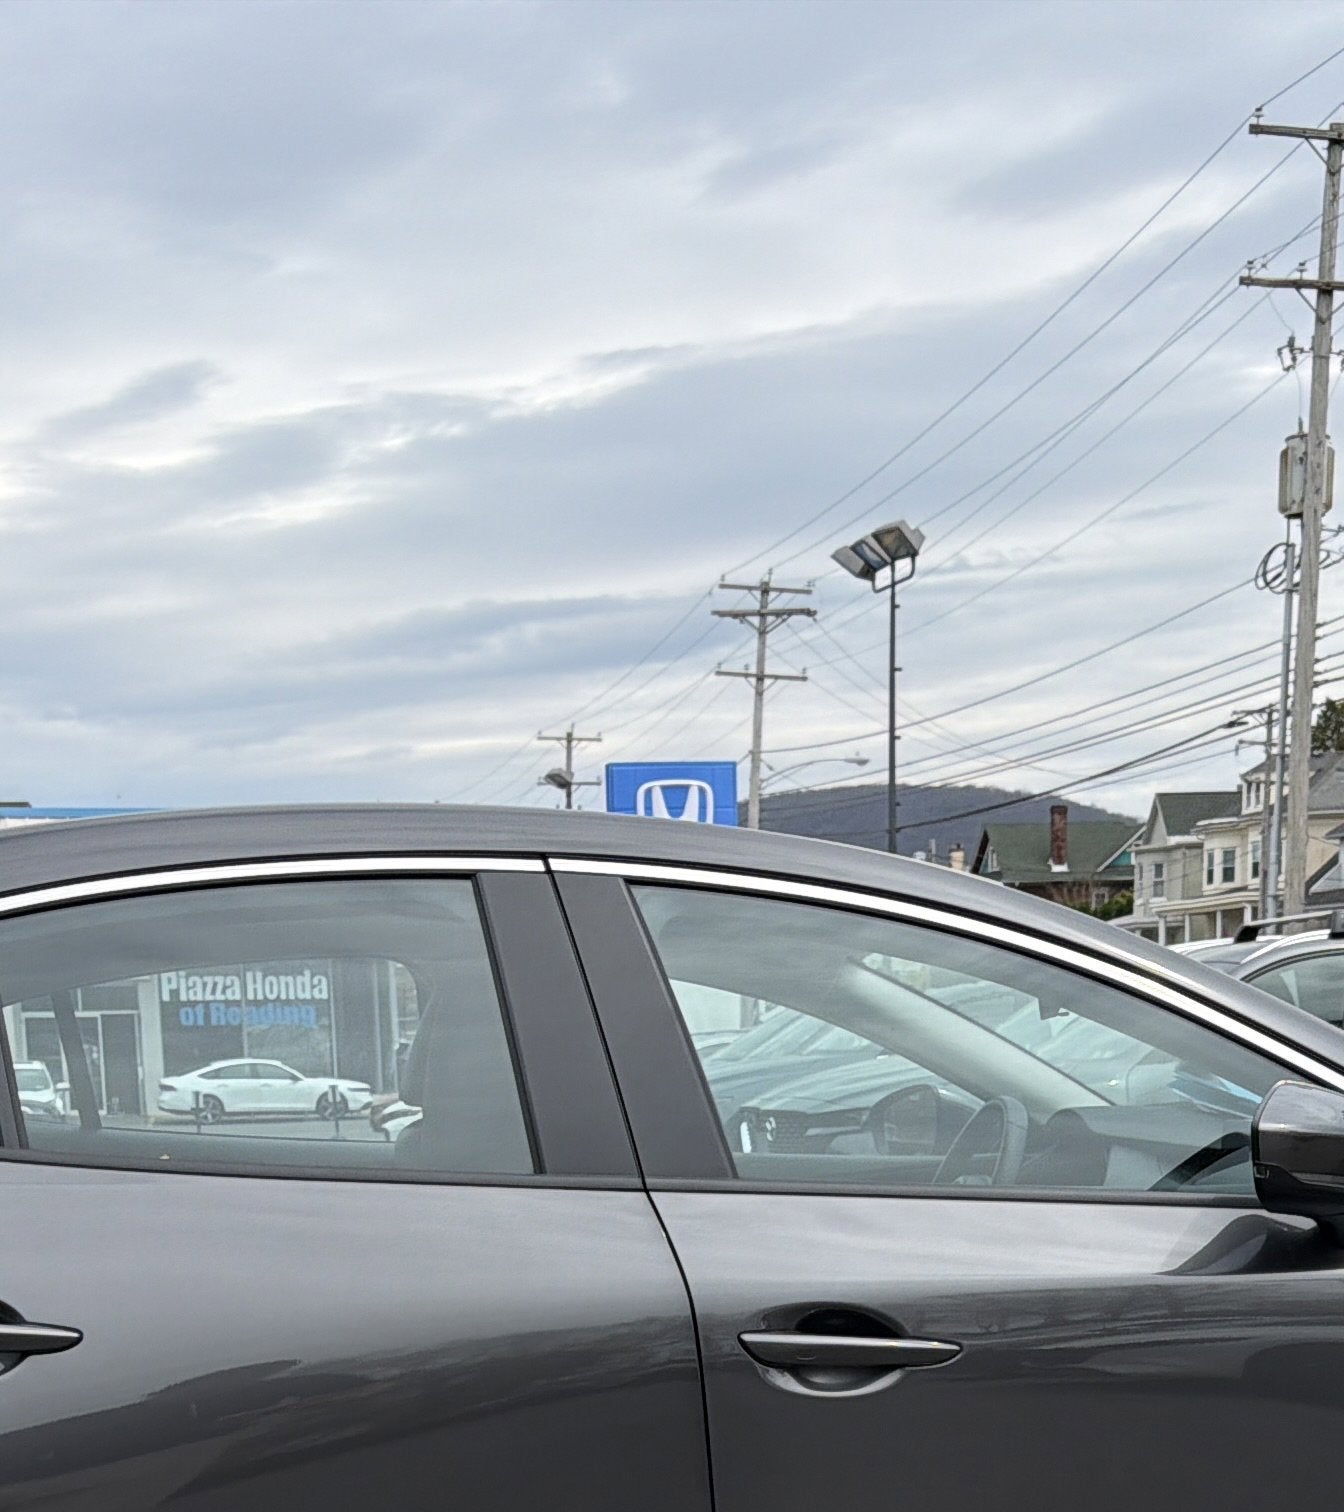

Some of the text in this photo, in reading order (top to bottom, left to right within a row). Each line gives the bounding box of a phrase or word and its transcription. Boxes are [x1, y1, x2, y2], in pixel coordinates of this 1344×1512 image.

[160, 969, 329, 1002] Piazza Honda
[179, 1002, 205, 1026] of
